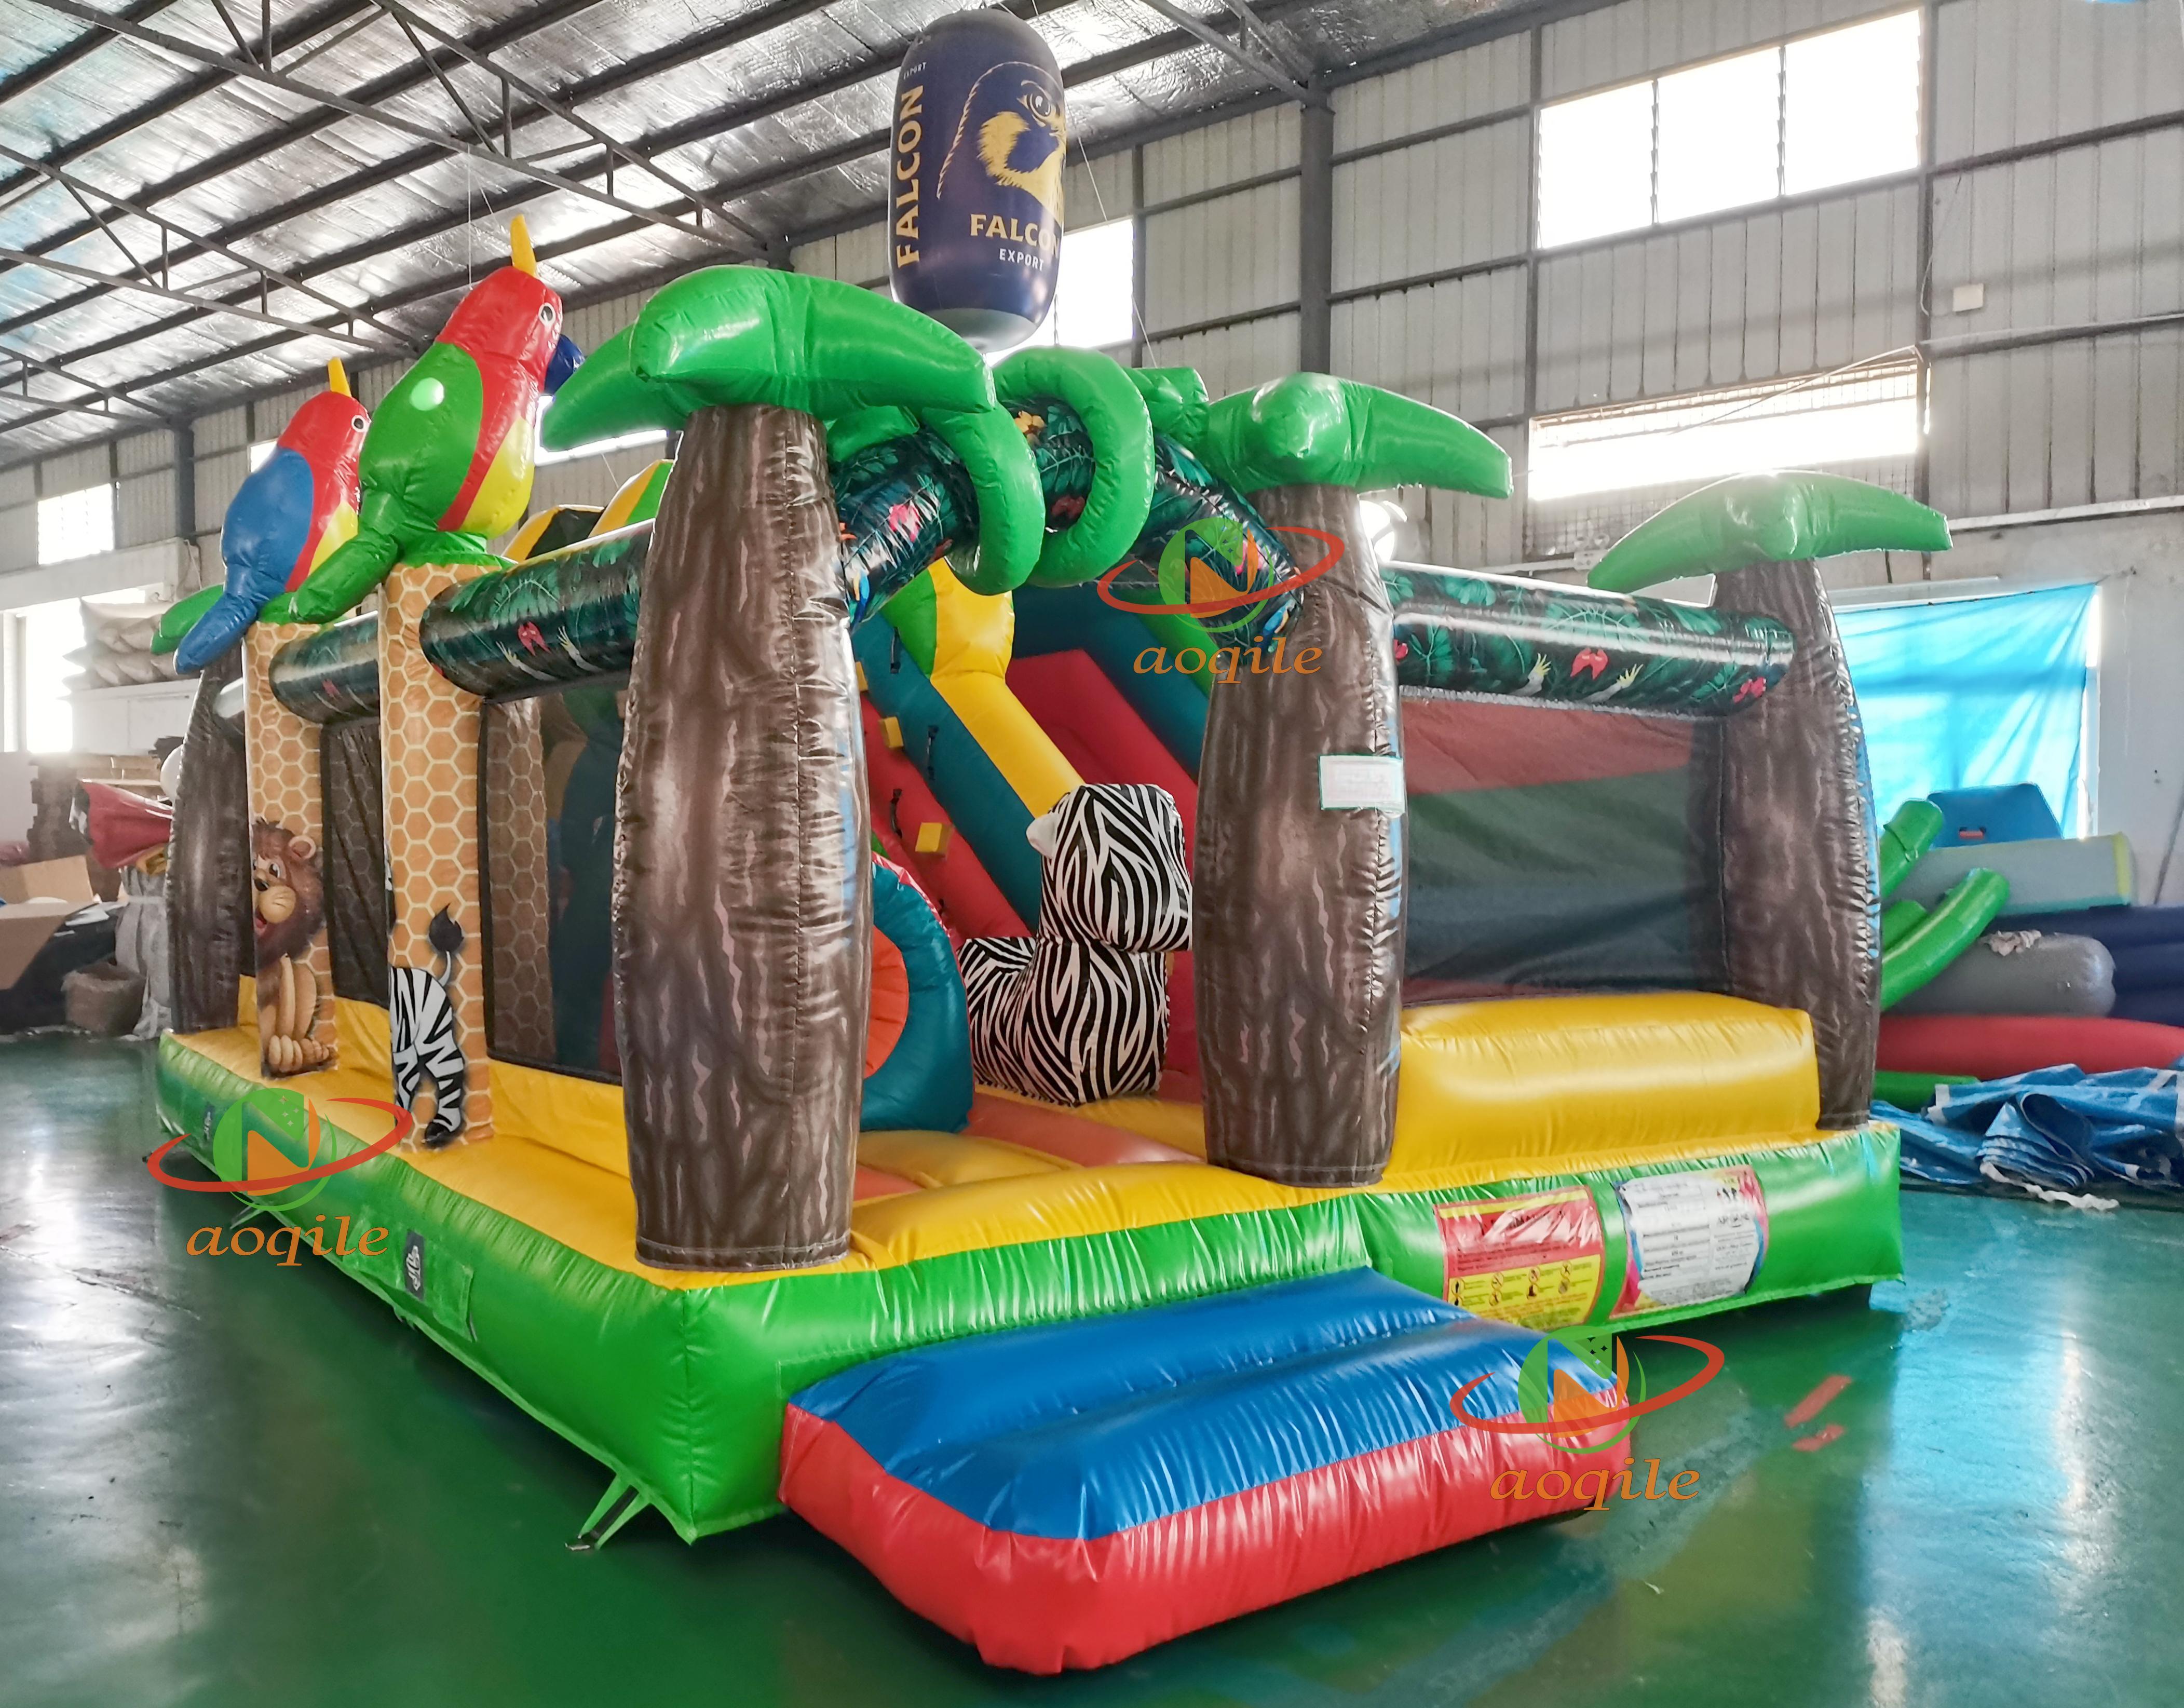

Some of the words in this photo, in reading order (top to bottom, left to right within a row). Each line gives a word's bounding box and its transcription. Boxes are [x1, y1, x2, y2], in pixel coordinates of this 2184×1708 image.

[896, 85, 924, 268] FALCON
[970, 213, 1060, 259] FALCON
[999, 248, 1044, 272] EXPORT
